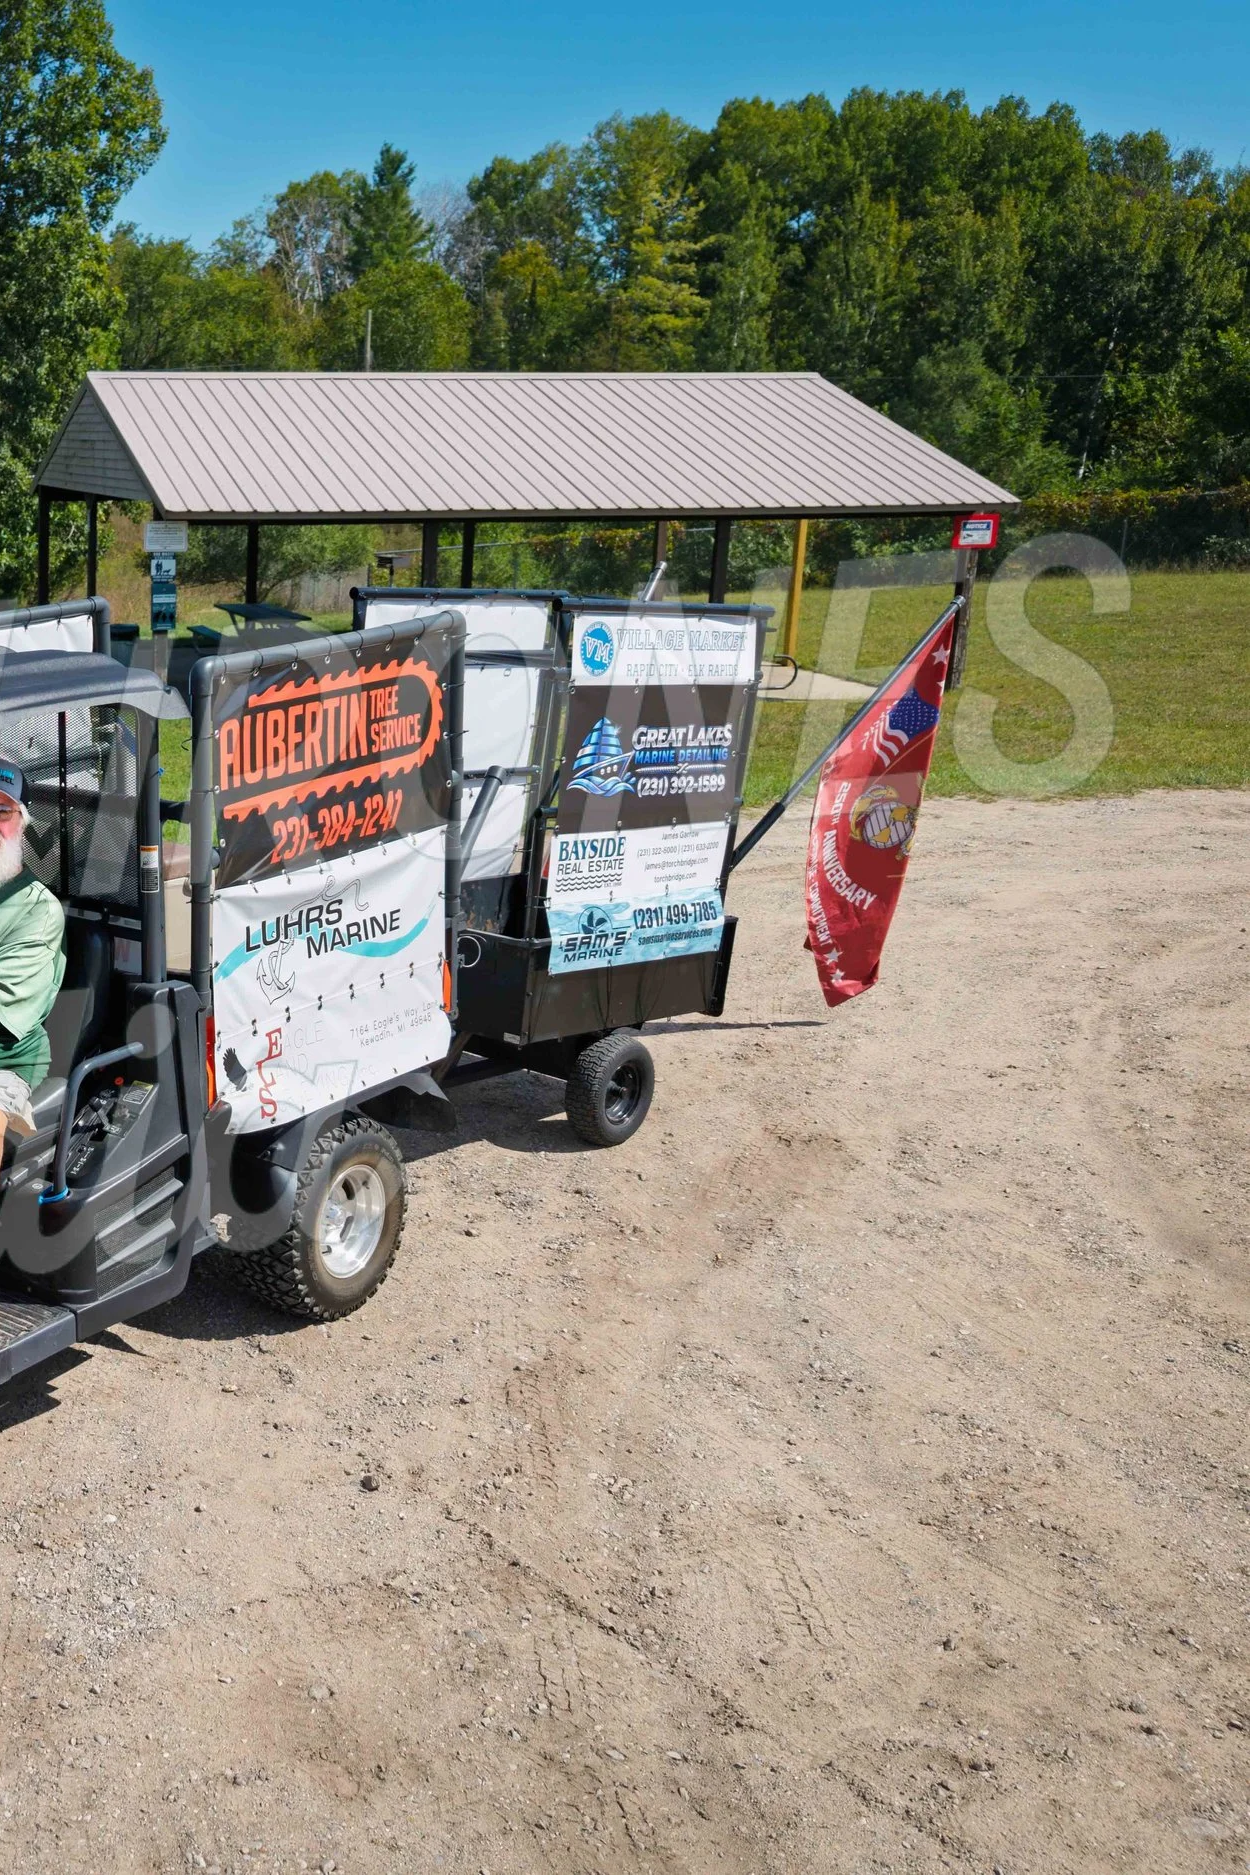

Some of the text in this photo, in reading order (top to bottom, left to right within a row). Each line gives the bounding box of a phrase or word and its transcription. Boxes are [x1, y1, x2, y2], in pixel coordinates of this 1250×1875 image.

[584, 636, 610, 664] VM
[616, 628, 685, 651] VILLAGE
[689, 630, 748, 651] MARKET
[626, 663, 739, 677] RAPID CITY ELK RAPIDS
[218, 685, 399, 791] AUBERTIN TREE
[370, 713, 422, 753] SERVICE
[632, 722, 733, 750] GREAT LAKES
[635, 748, 729, 764] MARINE DETAILING
[637, 774, 726, 798] (231) 392-1589
[269, 789, 403, 865] 231-384-1241
[558, 836, 626, 862] BAYSIDE
[557, 858, 624, 875] REAL ESTATE
[822, 829, 877, 911] ANNIVERSARY
[244, 898, 344, 953] LUHRS
[633, 900, 718, 930] (231) 499-7785
[306, 908, 402, 959] MARINE
[564, 931, 627, 952] SAM'S
[563, 946, 623, 963] MARINE
